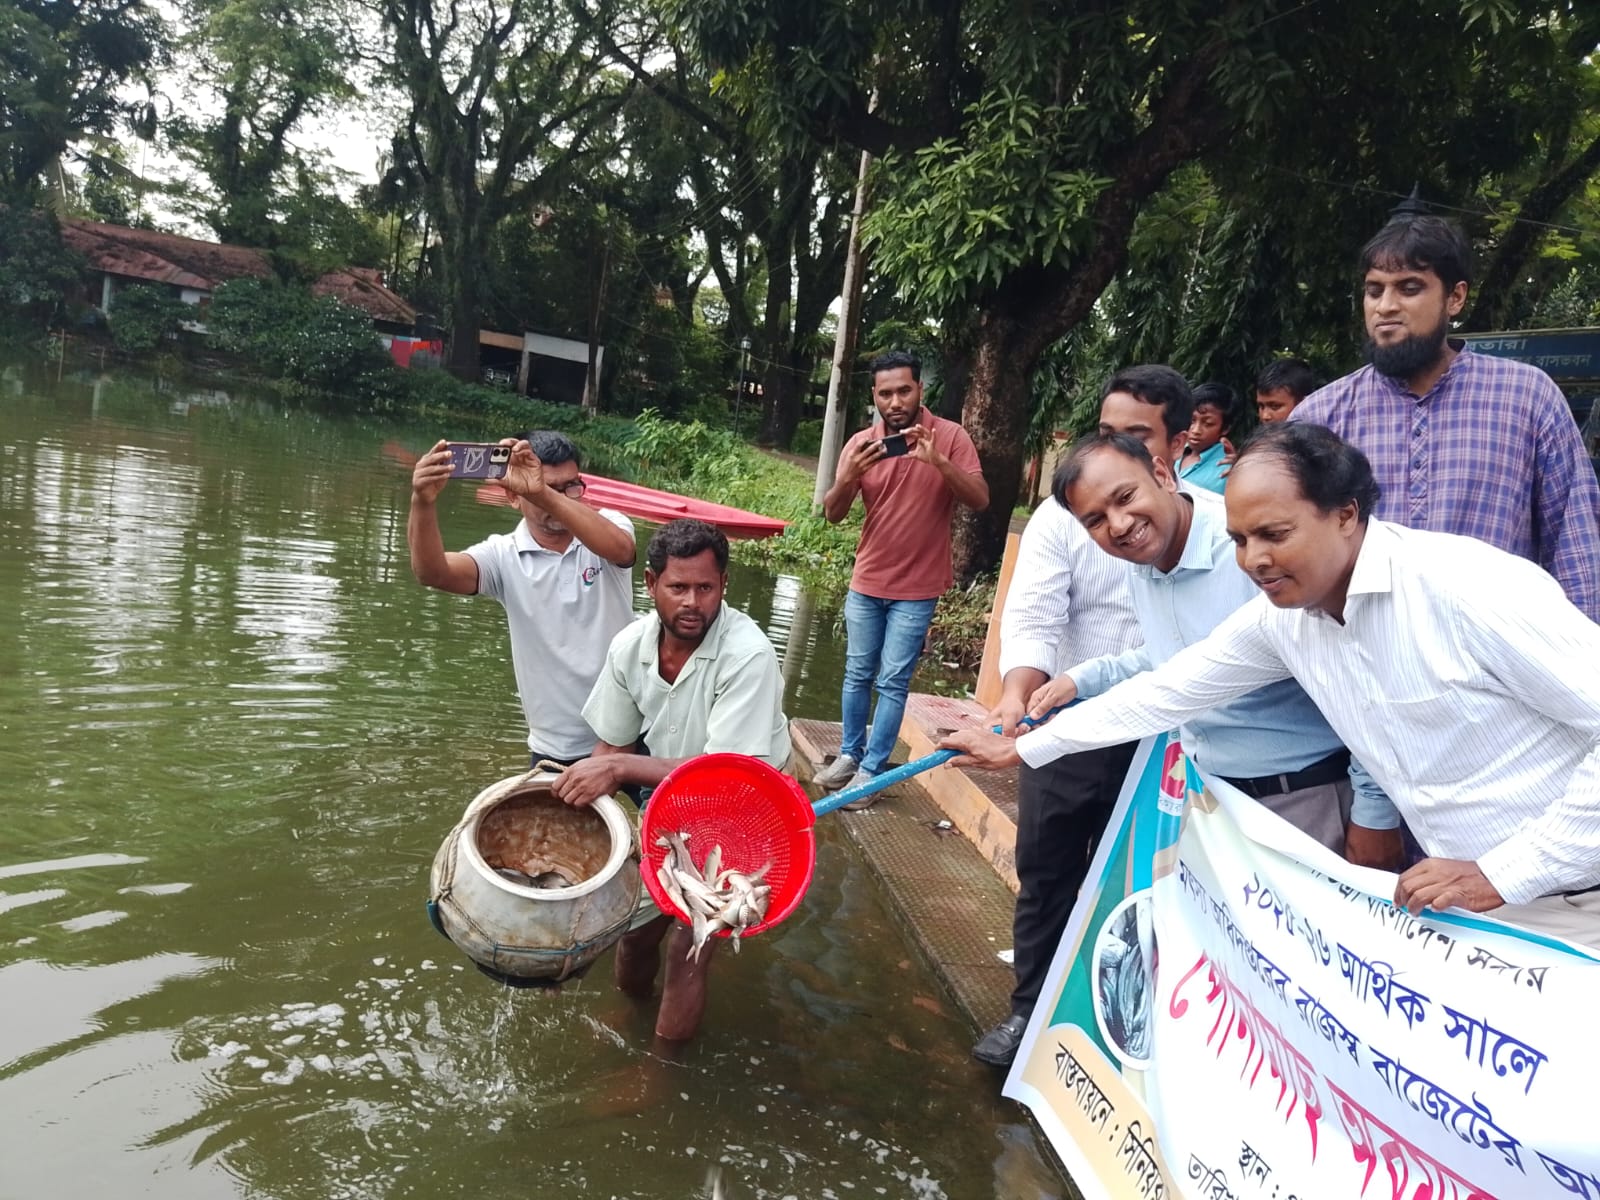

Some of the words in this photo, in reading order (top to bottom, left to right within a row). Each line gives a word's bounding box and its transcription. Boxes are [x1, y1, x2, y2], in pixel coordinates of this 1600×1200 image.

[1055, 1041, 1115, 1134] বাস্তবায়নে
[1294, 986, 1362, 1068] রাজস্ব
[1368, 1045, 1528, 1177] বাজেটের
[1337, 941, 1432, 1031] আর্থিক
[1442, 1004, 1549, 1097] সালে
